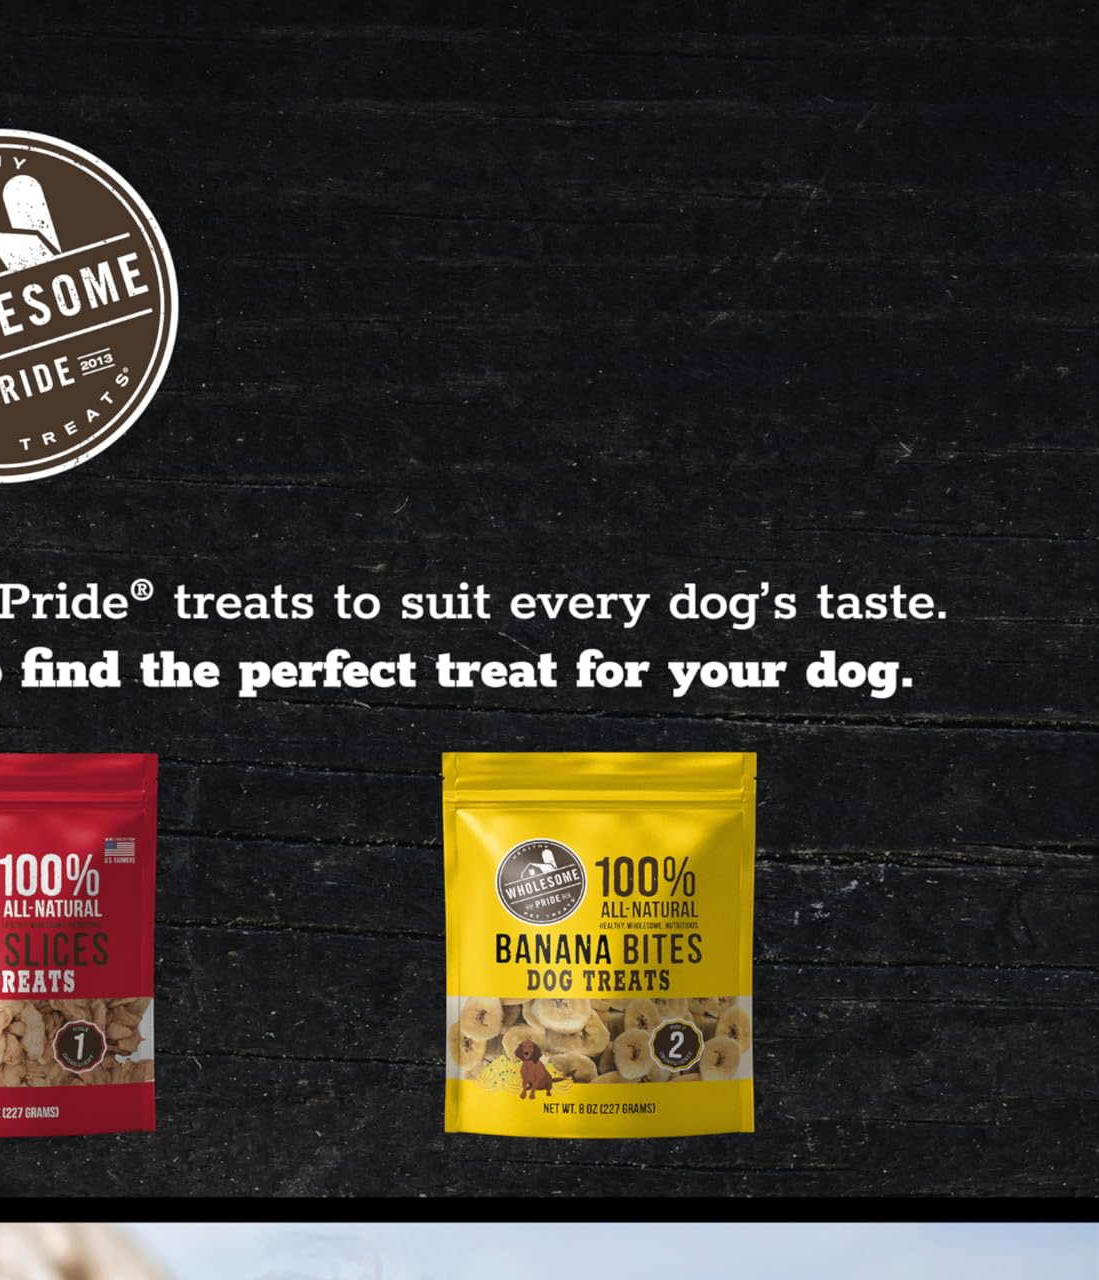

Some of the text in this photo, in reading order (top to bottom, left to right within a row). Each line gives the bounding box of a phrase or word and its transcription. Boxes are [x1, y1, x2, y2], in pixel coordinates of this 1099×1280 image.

[505, 868, 580, 900] WHOLESOME
[595, 856, 696, 897] 100%
[3, 900, 103, 918] ALL-NATURAL
[534, 894, 562, 909] PRIDE
[601, 900, 699, 918] ALL-NATURAL
[4, 932, 109, 967] SLICES
[495, 933, 703, 965] BANANA BITES
[527, 968, 670, 992] DOG TREATS
[74, 1033, 85, 1060] 1
[669, 1031, 684, 1059] 2
[2, 1107, 23, 1119] (227
[24, 1106, 59, 1118] GRAMS)
[543, 1102, 656, 1115] NET WT. 8 OZ (227 GRAMS)
